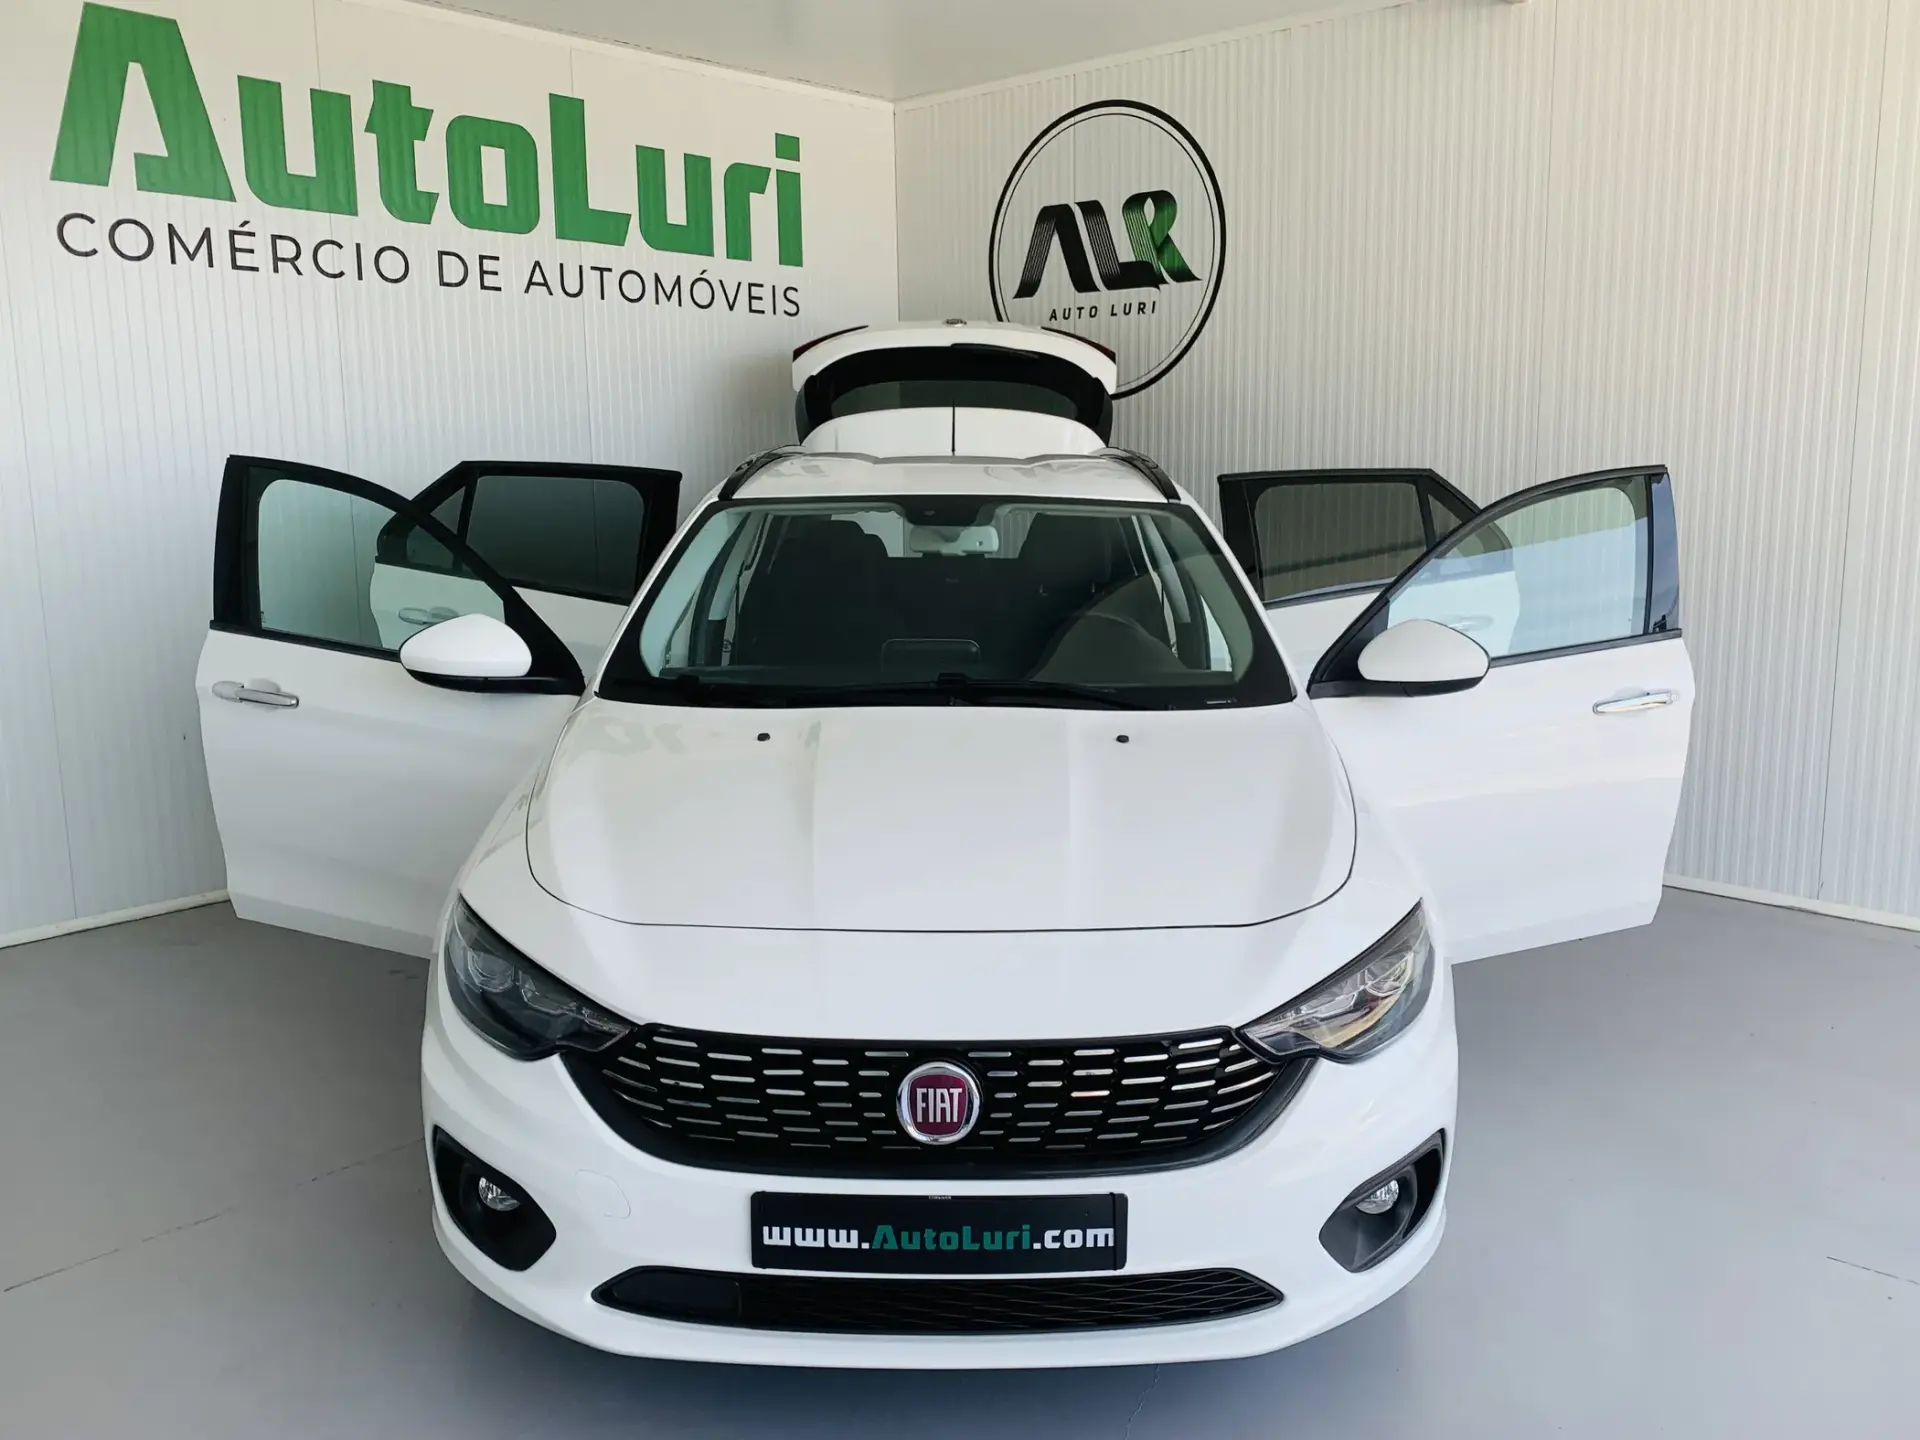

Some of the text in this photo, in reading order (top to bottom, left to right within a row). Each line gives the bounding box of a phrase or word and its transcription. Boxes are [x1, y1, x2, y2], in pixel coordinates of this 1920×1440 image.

[50, 2, 802, 267] AutoLuri
[55, 211, 801, 318] COMÉRCIO DE AUTOMÓVEIS
[1049, 300, 1157, 322] AUTO LURI
[916, 1088, 963, 1123] FIAT
[762, 1225, 1114, 1250] www.AutoLuri.com
